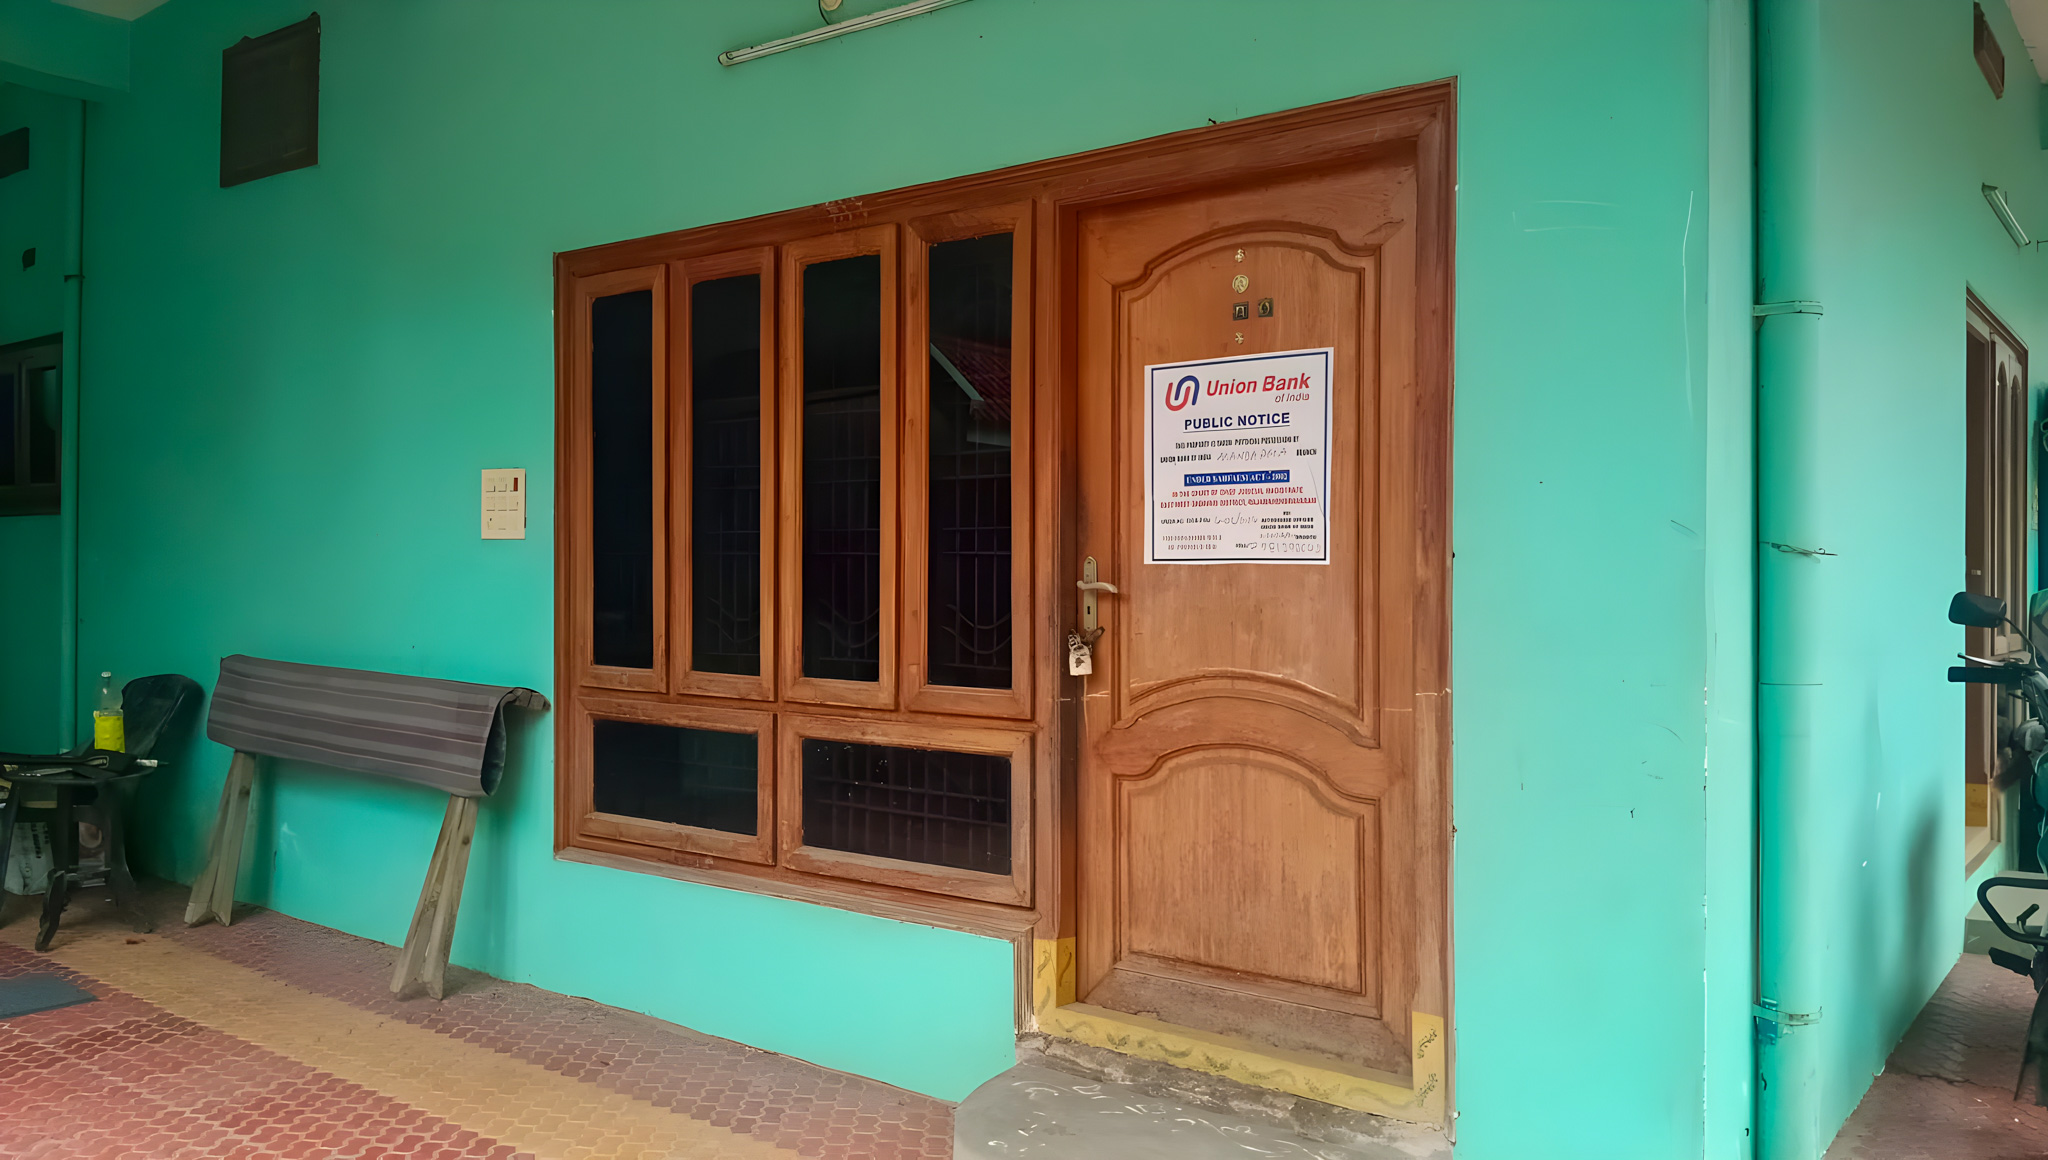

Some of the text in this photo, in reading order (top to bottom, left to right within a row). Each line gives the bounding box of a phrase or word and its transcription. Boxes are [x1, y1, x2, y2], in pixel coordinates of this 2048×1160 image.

[1207, 372, 1311, 397] Union Bank
[1275, 392, 1310, 403] of India
[1184, 412, 1290, 430] PUBLIC NOTICE
